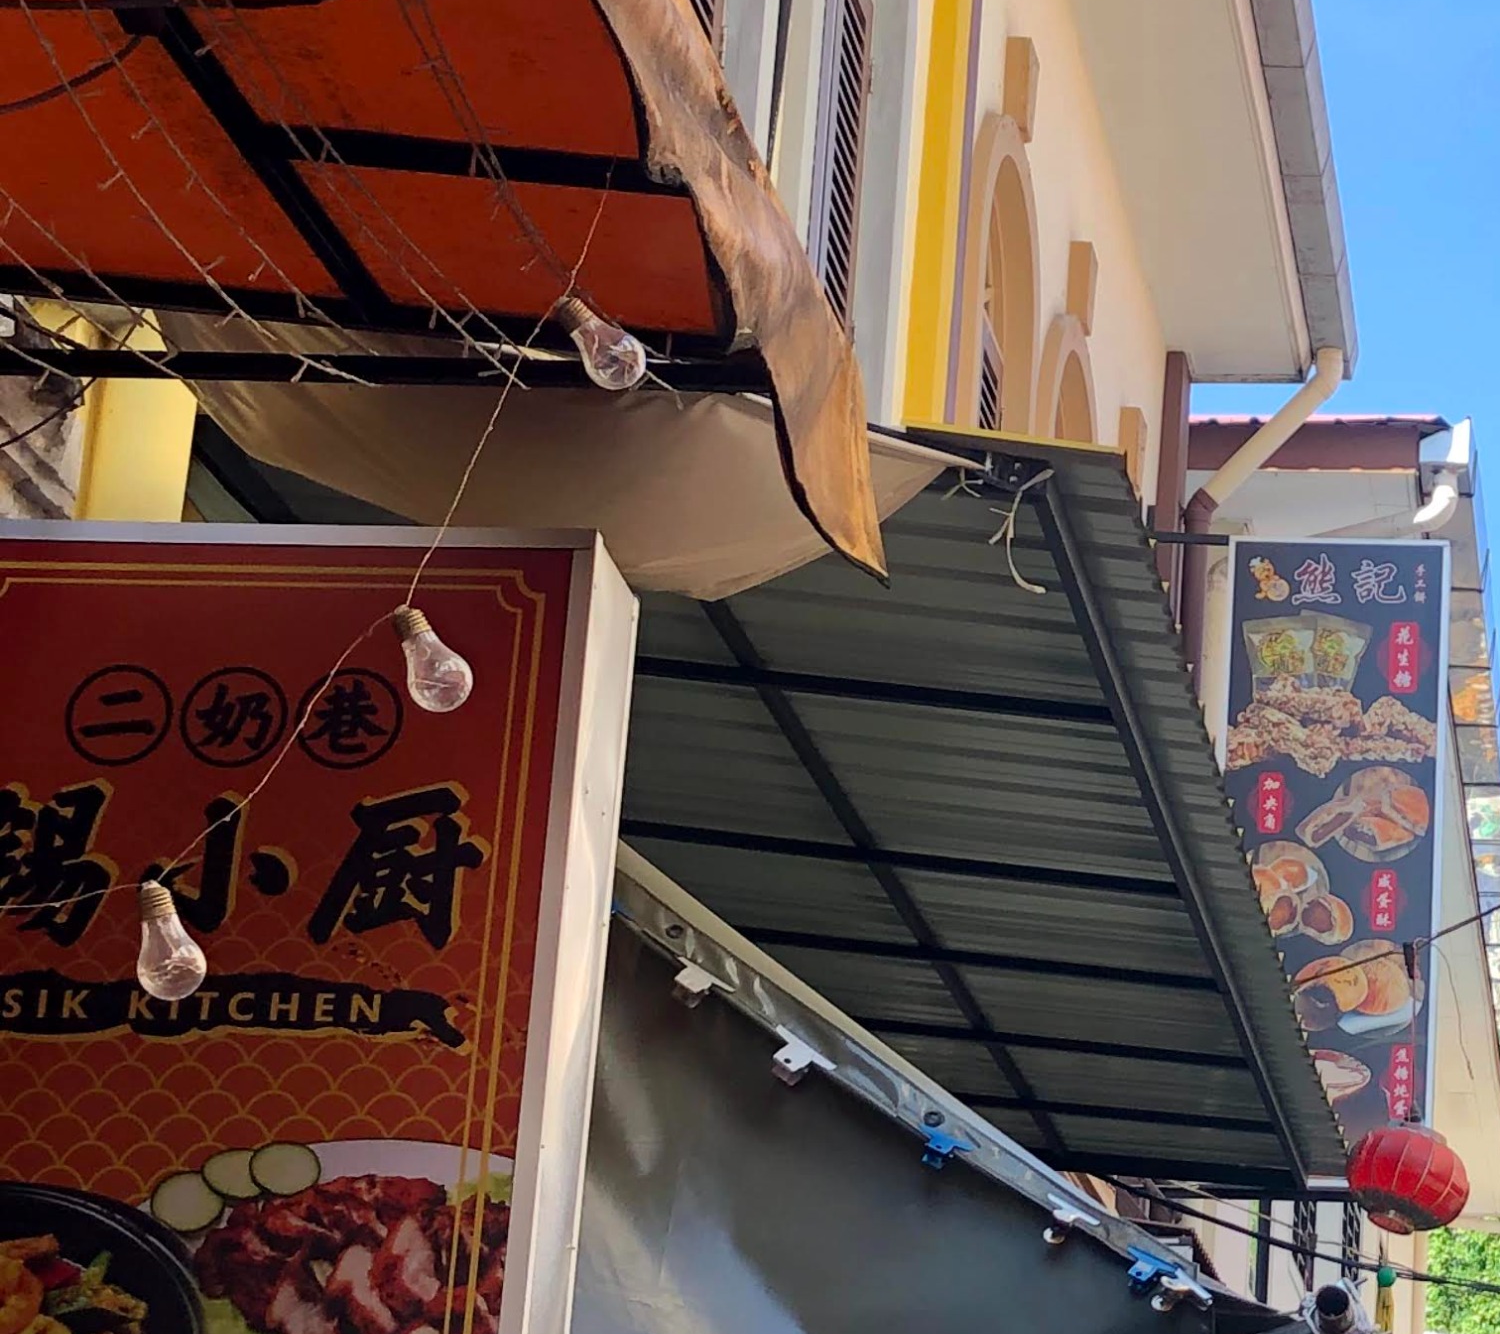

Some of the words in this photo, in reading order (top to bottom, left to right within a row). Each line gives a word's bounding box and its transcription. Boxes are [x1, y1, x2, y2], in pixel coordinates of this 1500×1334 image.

[1291, 553, 1407, 605] 熊記
[74, 675, 394, 762] 二奶巷
[2, 988, 91, 1019] SIK
[127, 990, 383, 1024] KITCHEN
